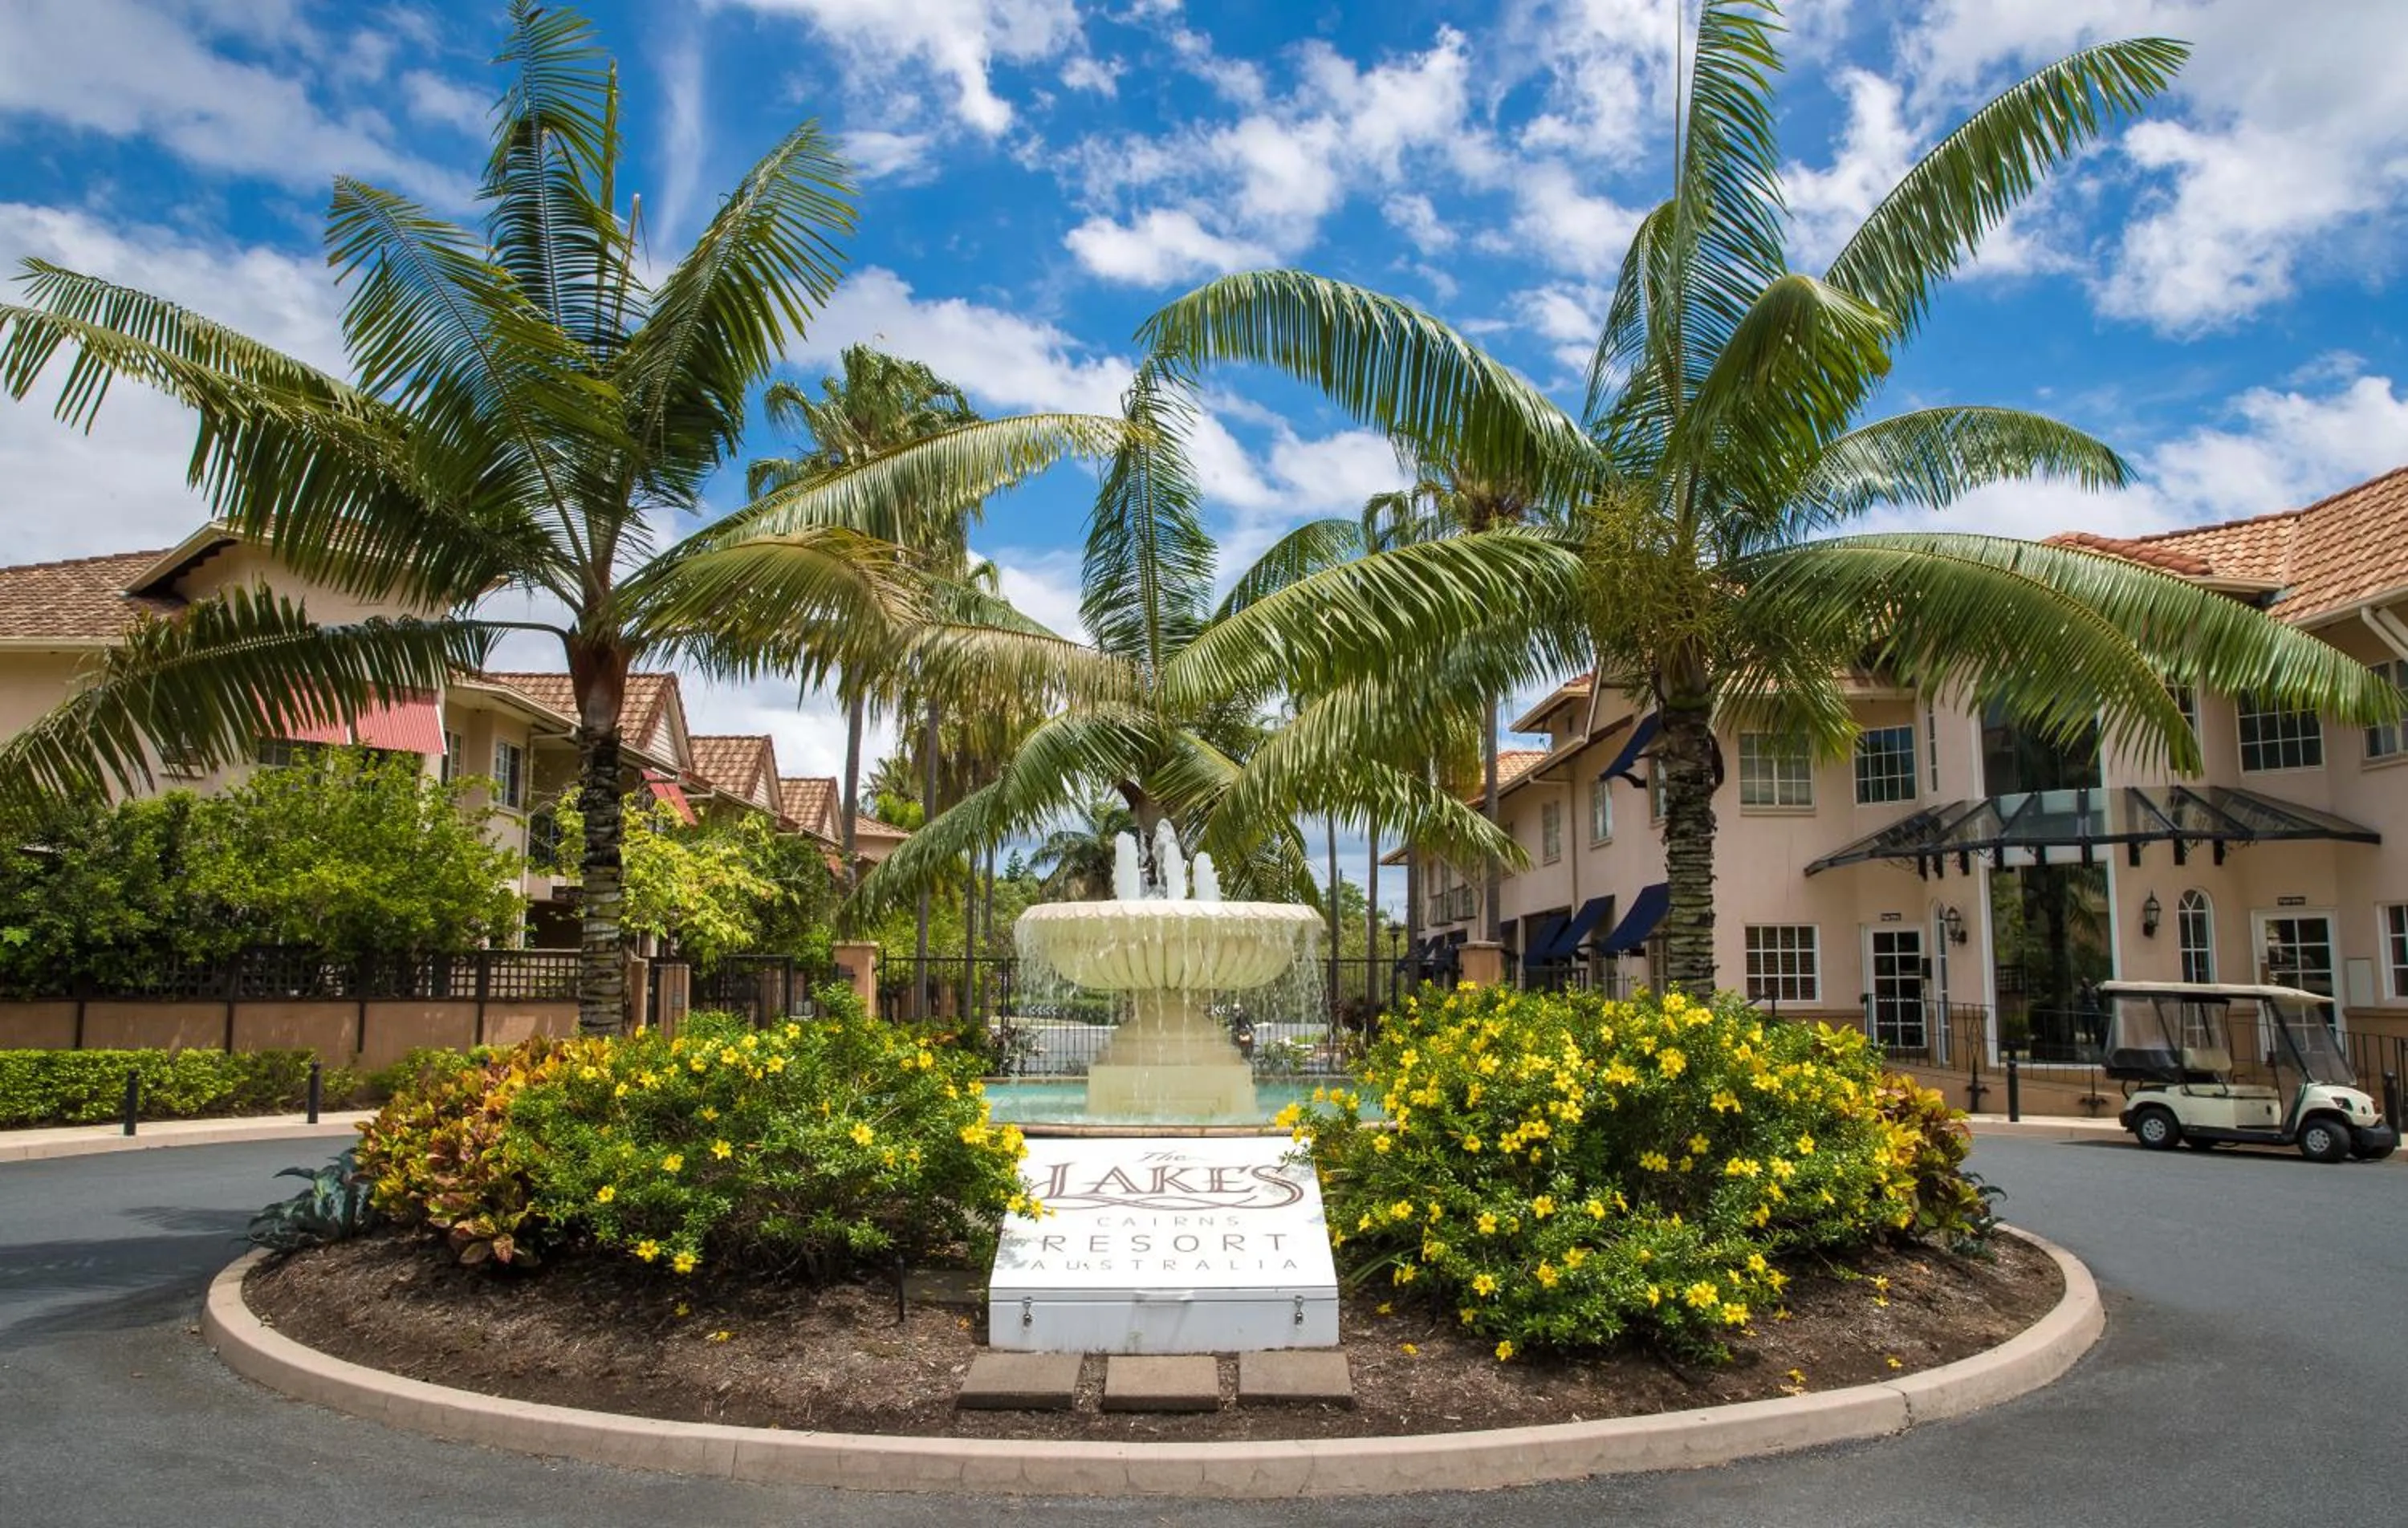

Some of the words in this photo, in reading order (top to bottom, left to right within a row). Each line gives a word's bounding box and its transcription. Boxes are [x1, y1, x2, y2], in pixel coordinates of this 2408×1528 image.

[1031, 1161, 1304, 1210] LAKES
[1096, 1216, 1240, 1227] CAIRNS
[1042, 1233, 1287, 1253] RESORT
[1031, 1258, 1298, 1270] AUSTRALIA
